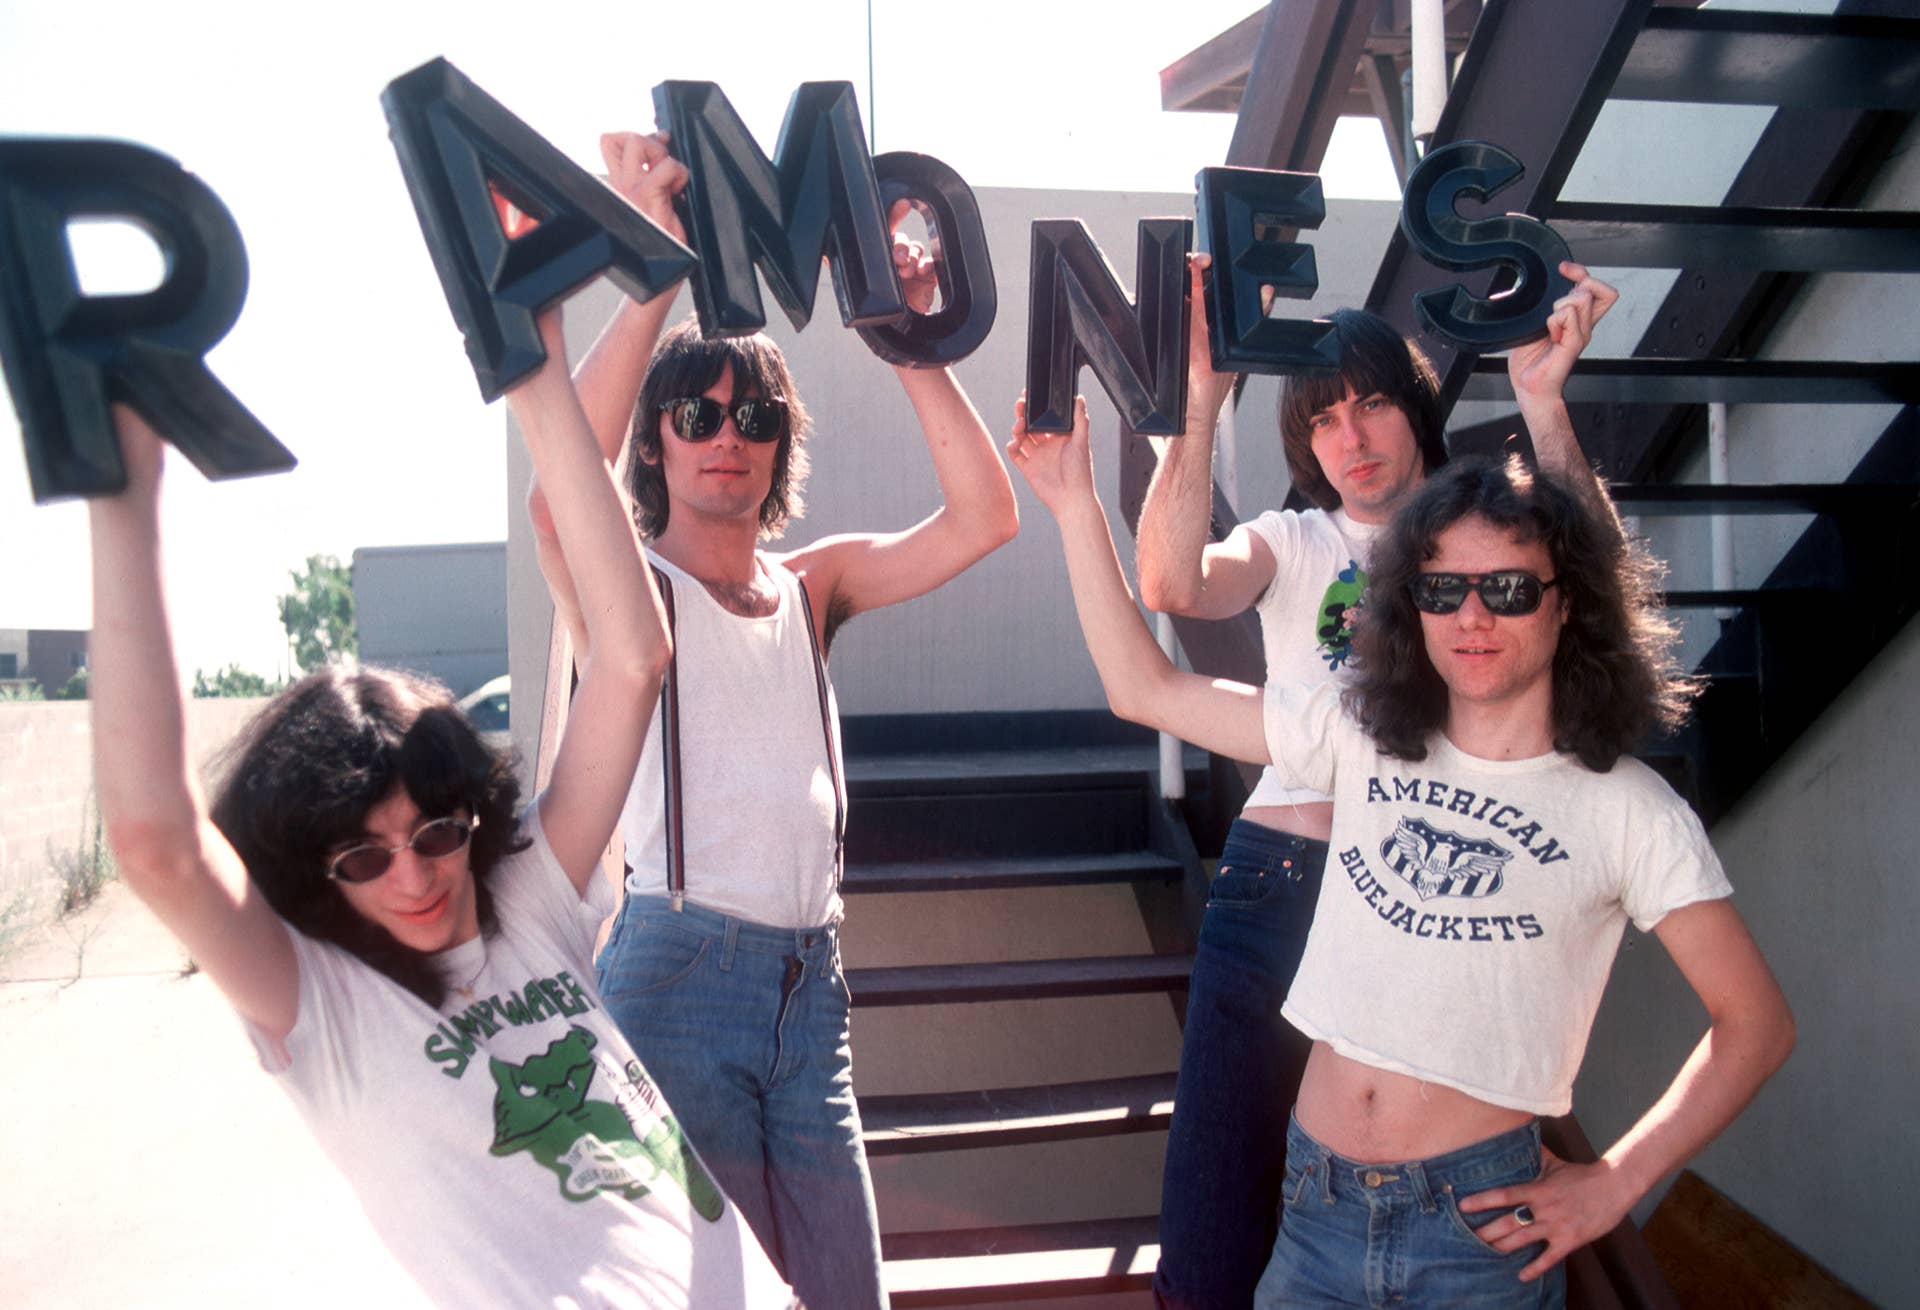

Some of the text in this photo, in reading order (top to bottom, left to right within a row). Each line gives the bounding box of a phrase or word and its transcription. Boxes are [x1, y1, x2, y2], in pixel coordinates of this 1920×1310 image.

[0, 56, 1572, 502] RAMONES
[1367, 776, 1570, 865] AMERICAN
[1339, 846, 1544, 942] BLUEJACKETS
